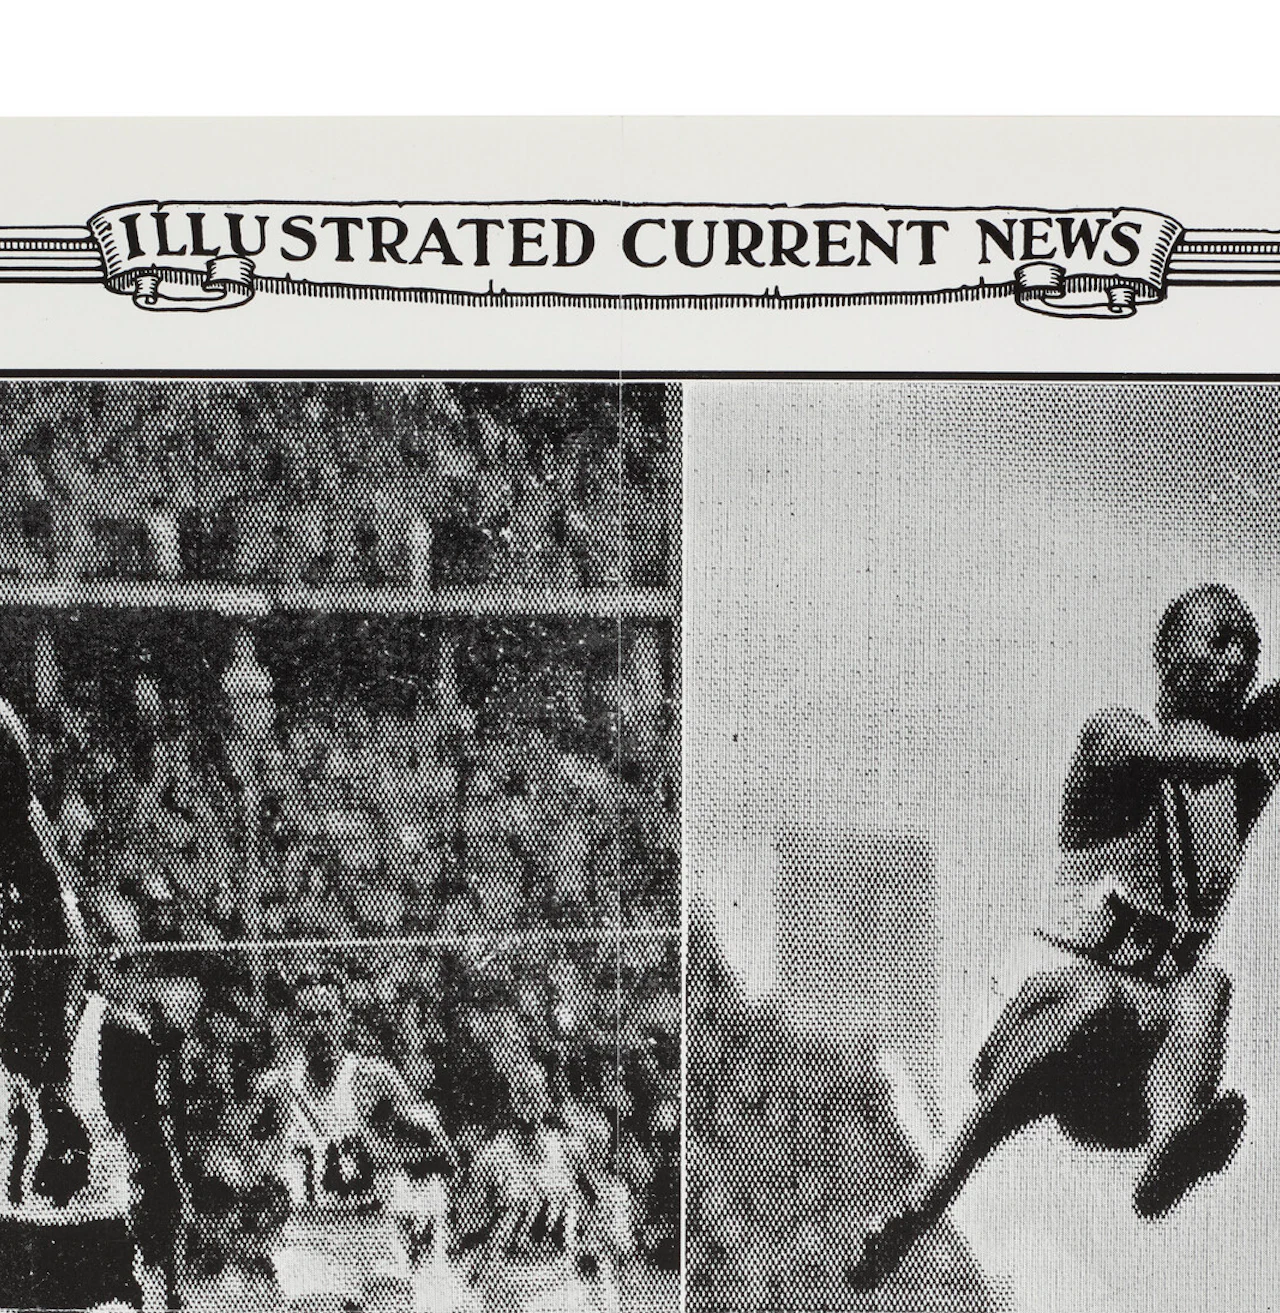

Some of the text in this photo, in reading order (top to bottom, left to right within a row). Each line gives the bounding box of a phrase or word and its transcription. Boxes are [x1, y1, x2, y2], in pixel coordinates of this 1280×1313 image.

[120, 210, 1142, 267] ILLUSTRATED CURRENT NEWS
